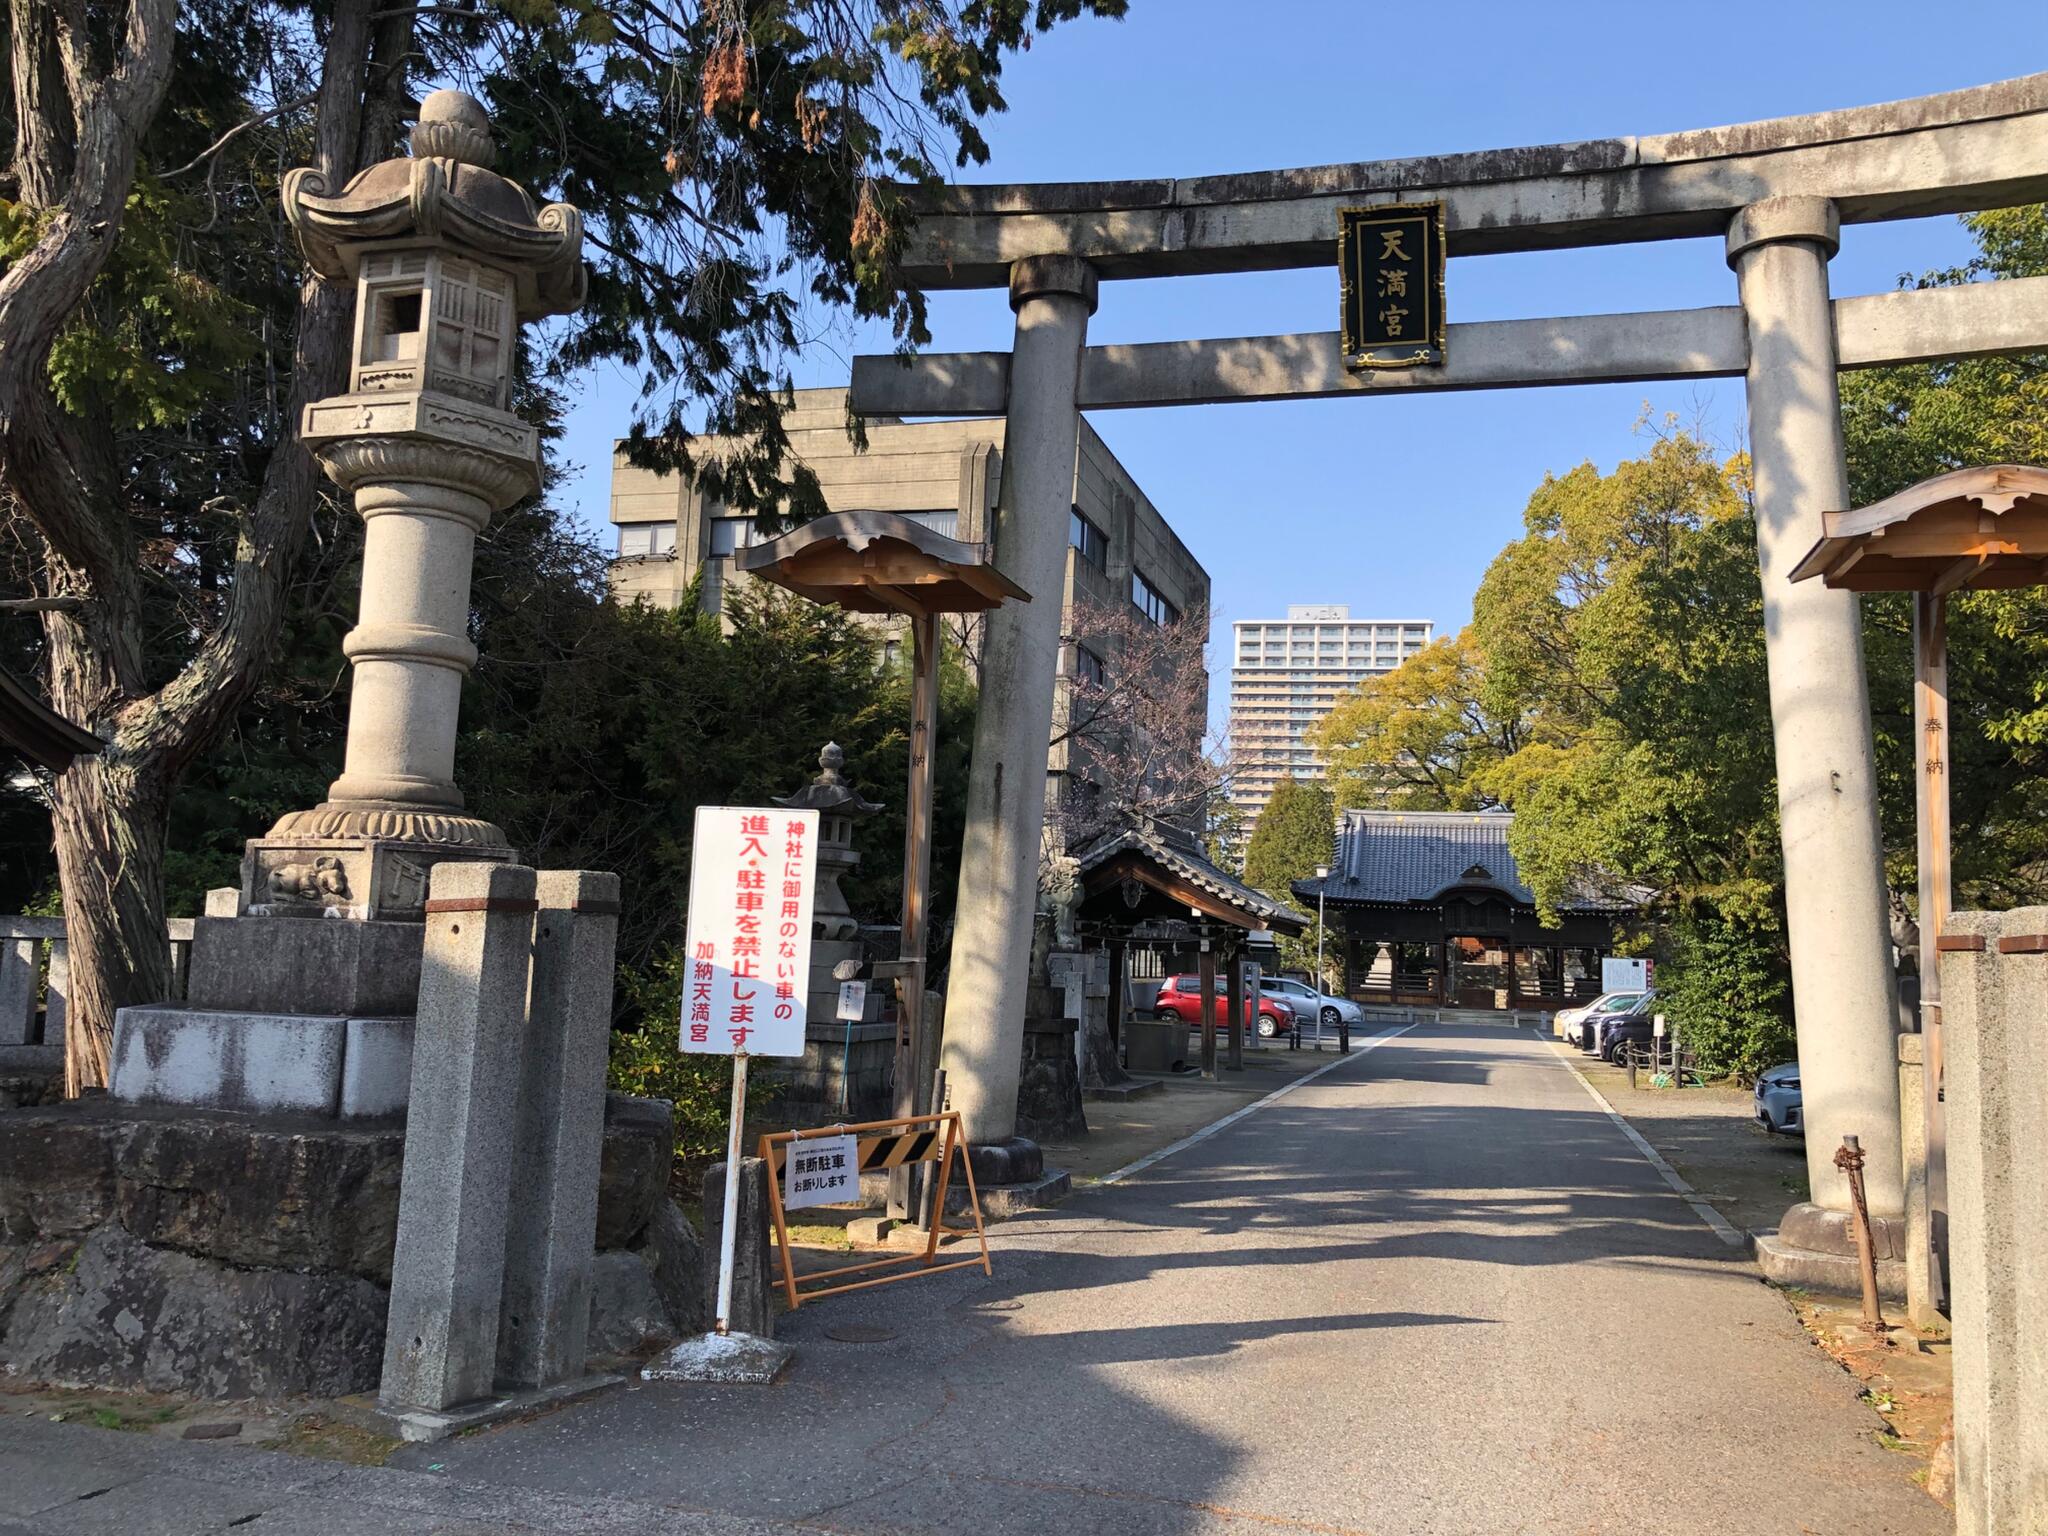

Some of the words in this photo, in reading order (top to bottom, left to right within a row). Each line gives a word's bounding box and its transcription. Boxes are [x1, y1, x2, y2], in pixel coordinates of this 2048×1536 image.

[1376, 229, 1413, 338] 天満宮
[1924, 716, 1943, 775] 奉納
[727, 815, 770, 1047] 進入・駐車を禁止します
[774, 820, 806, 1020] 神社に御用のない車の
[690, 942, 715, 1043] 加納天満宮
[794, 1174, 848, 1193] お断りします
[795, 1153, 846, 1174] 無断駐車
